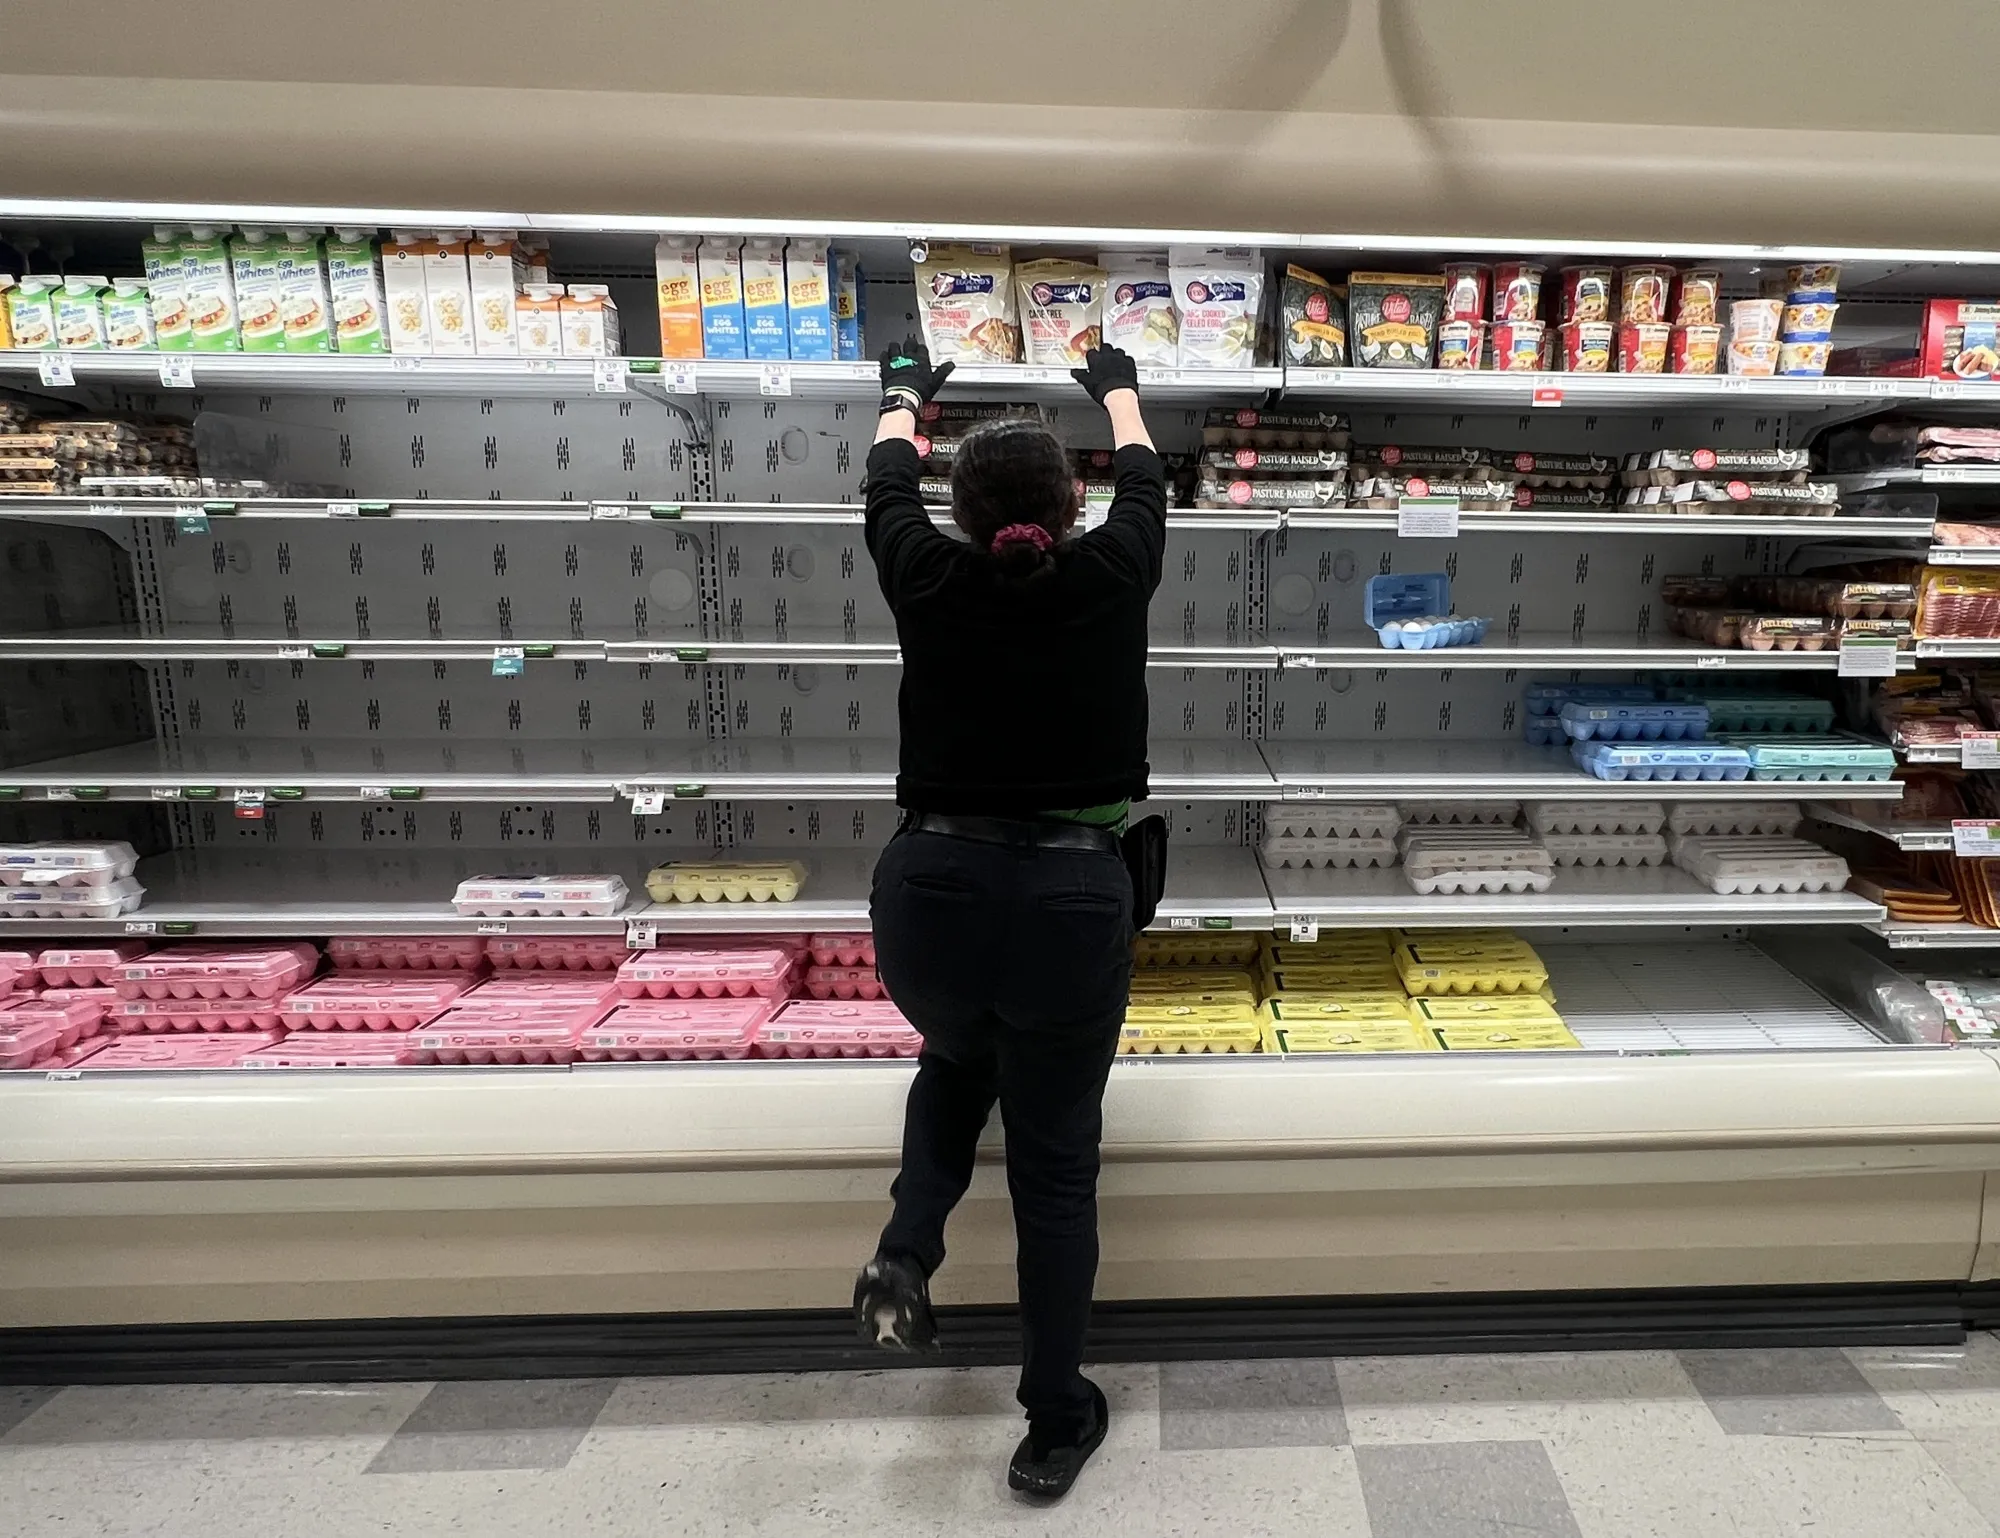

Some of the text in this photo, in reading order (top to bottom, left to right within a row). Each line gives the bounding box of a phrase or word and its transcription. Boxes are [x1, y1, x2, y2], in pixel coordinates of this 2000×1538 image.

[146, 260, 160, 269] Egg
[183, 258, 198, 267] Egg
[235, 260, 251, 269] Egg
[278, 260, 293, 269] Egg
[330, 260, 345, 269] Egg
[148, 267, 182, 280] Whites
[184, 265, 221, 279] Whites
[237, 267, 274, 280] Whites
[280, 268, 315, 280] Whites
[332, 268, 368, 280] Whites
[661, 280, 689, 296] egg
[704, 280, 732, 296] egg
[747, 281, 775, 296] egg
[791, 282, 819, 297] egg
[1382, 298, 1409, 314] Vital
[801, 320, 819, 328] EGG
[707, 326, 739, 335] WHITES
[750, 327, 782, 336] WHITES
[794, 328, 826, 336] WHITES
[1236, 451, 1319, 466] Vital PASTURE RAISED
[1252, 489, 1284, 499] PASTURE
[1286, 489, 1315, 499] RAISED
[1461, 486, 1488, 495] RAISED
